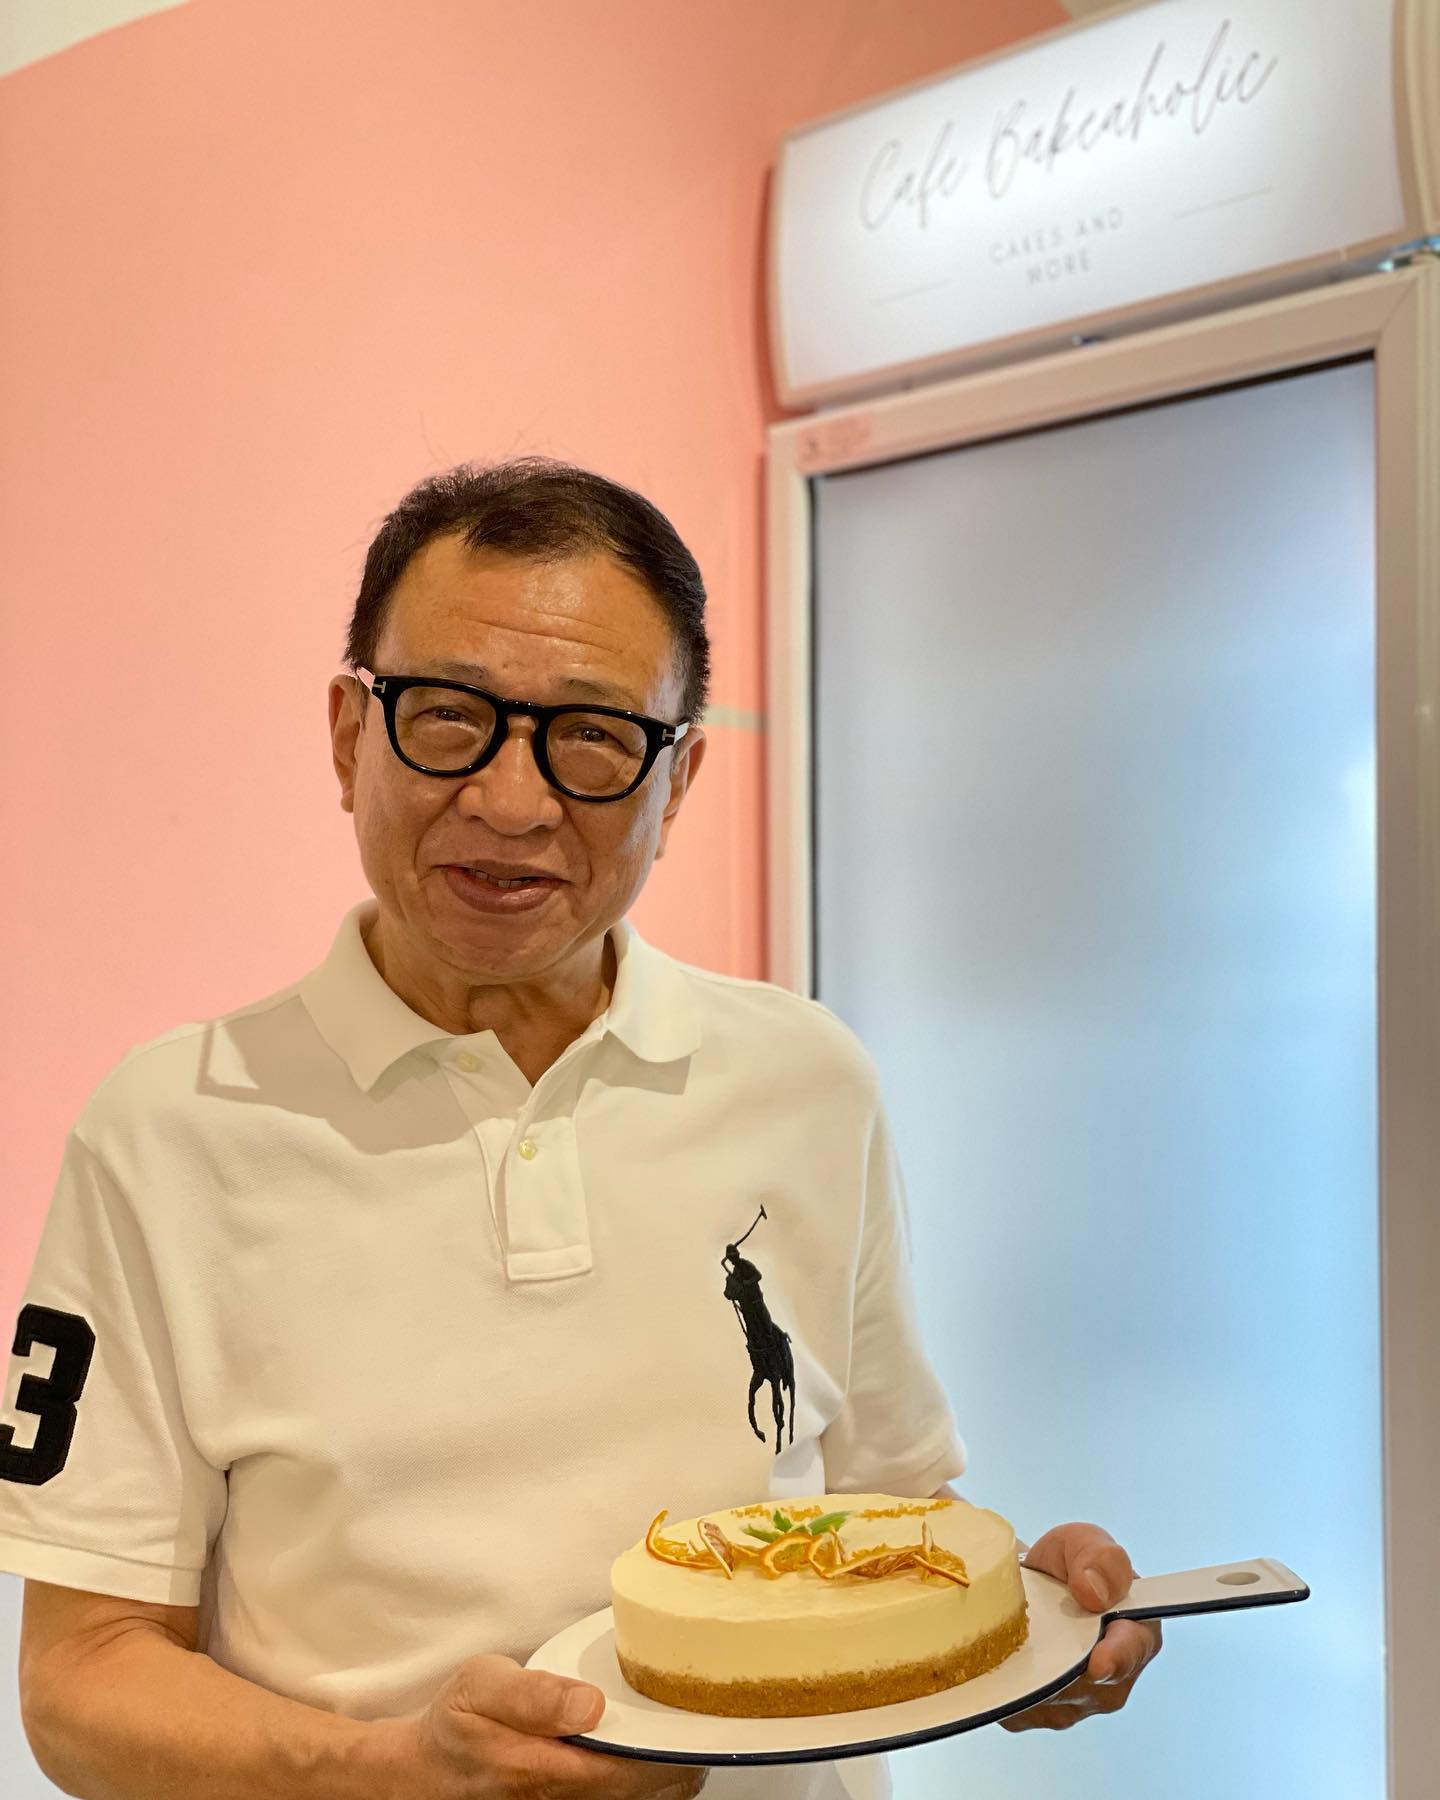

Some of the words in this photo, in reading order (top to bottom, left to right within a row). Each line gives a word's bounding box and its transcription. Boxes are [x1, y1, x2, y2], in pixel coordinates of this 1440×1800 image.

[860, 120, 967, 230] Cafe
[985, 19, 1278, 199] Bakeaholic
[989, 226, 1063, 265] CAKES
[1076, 207, 1122, 236] AND
[1026, 249, 1090, 284] MORE
[0, 1303, 96, 1486] 3
